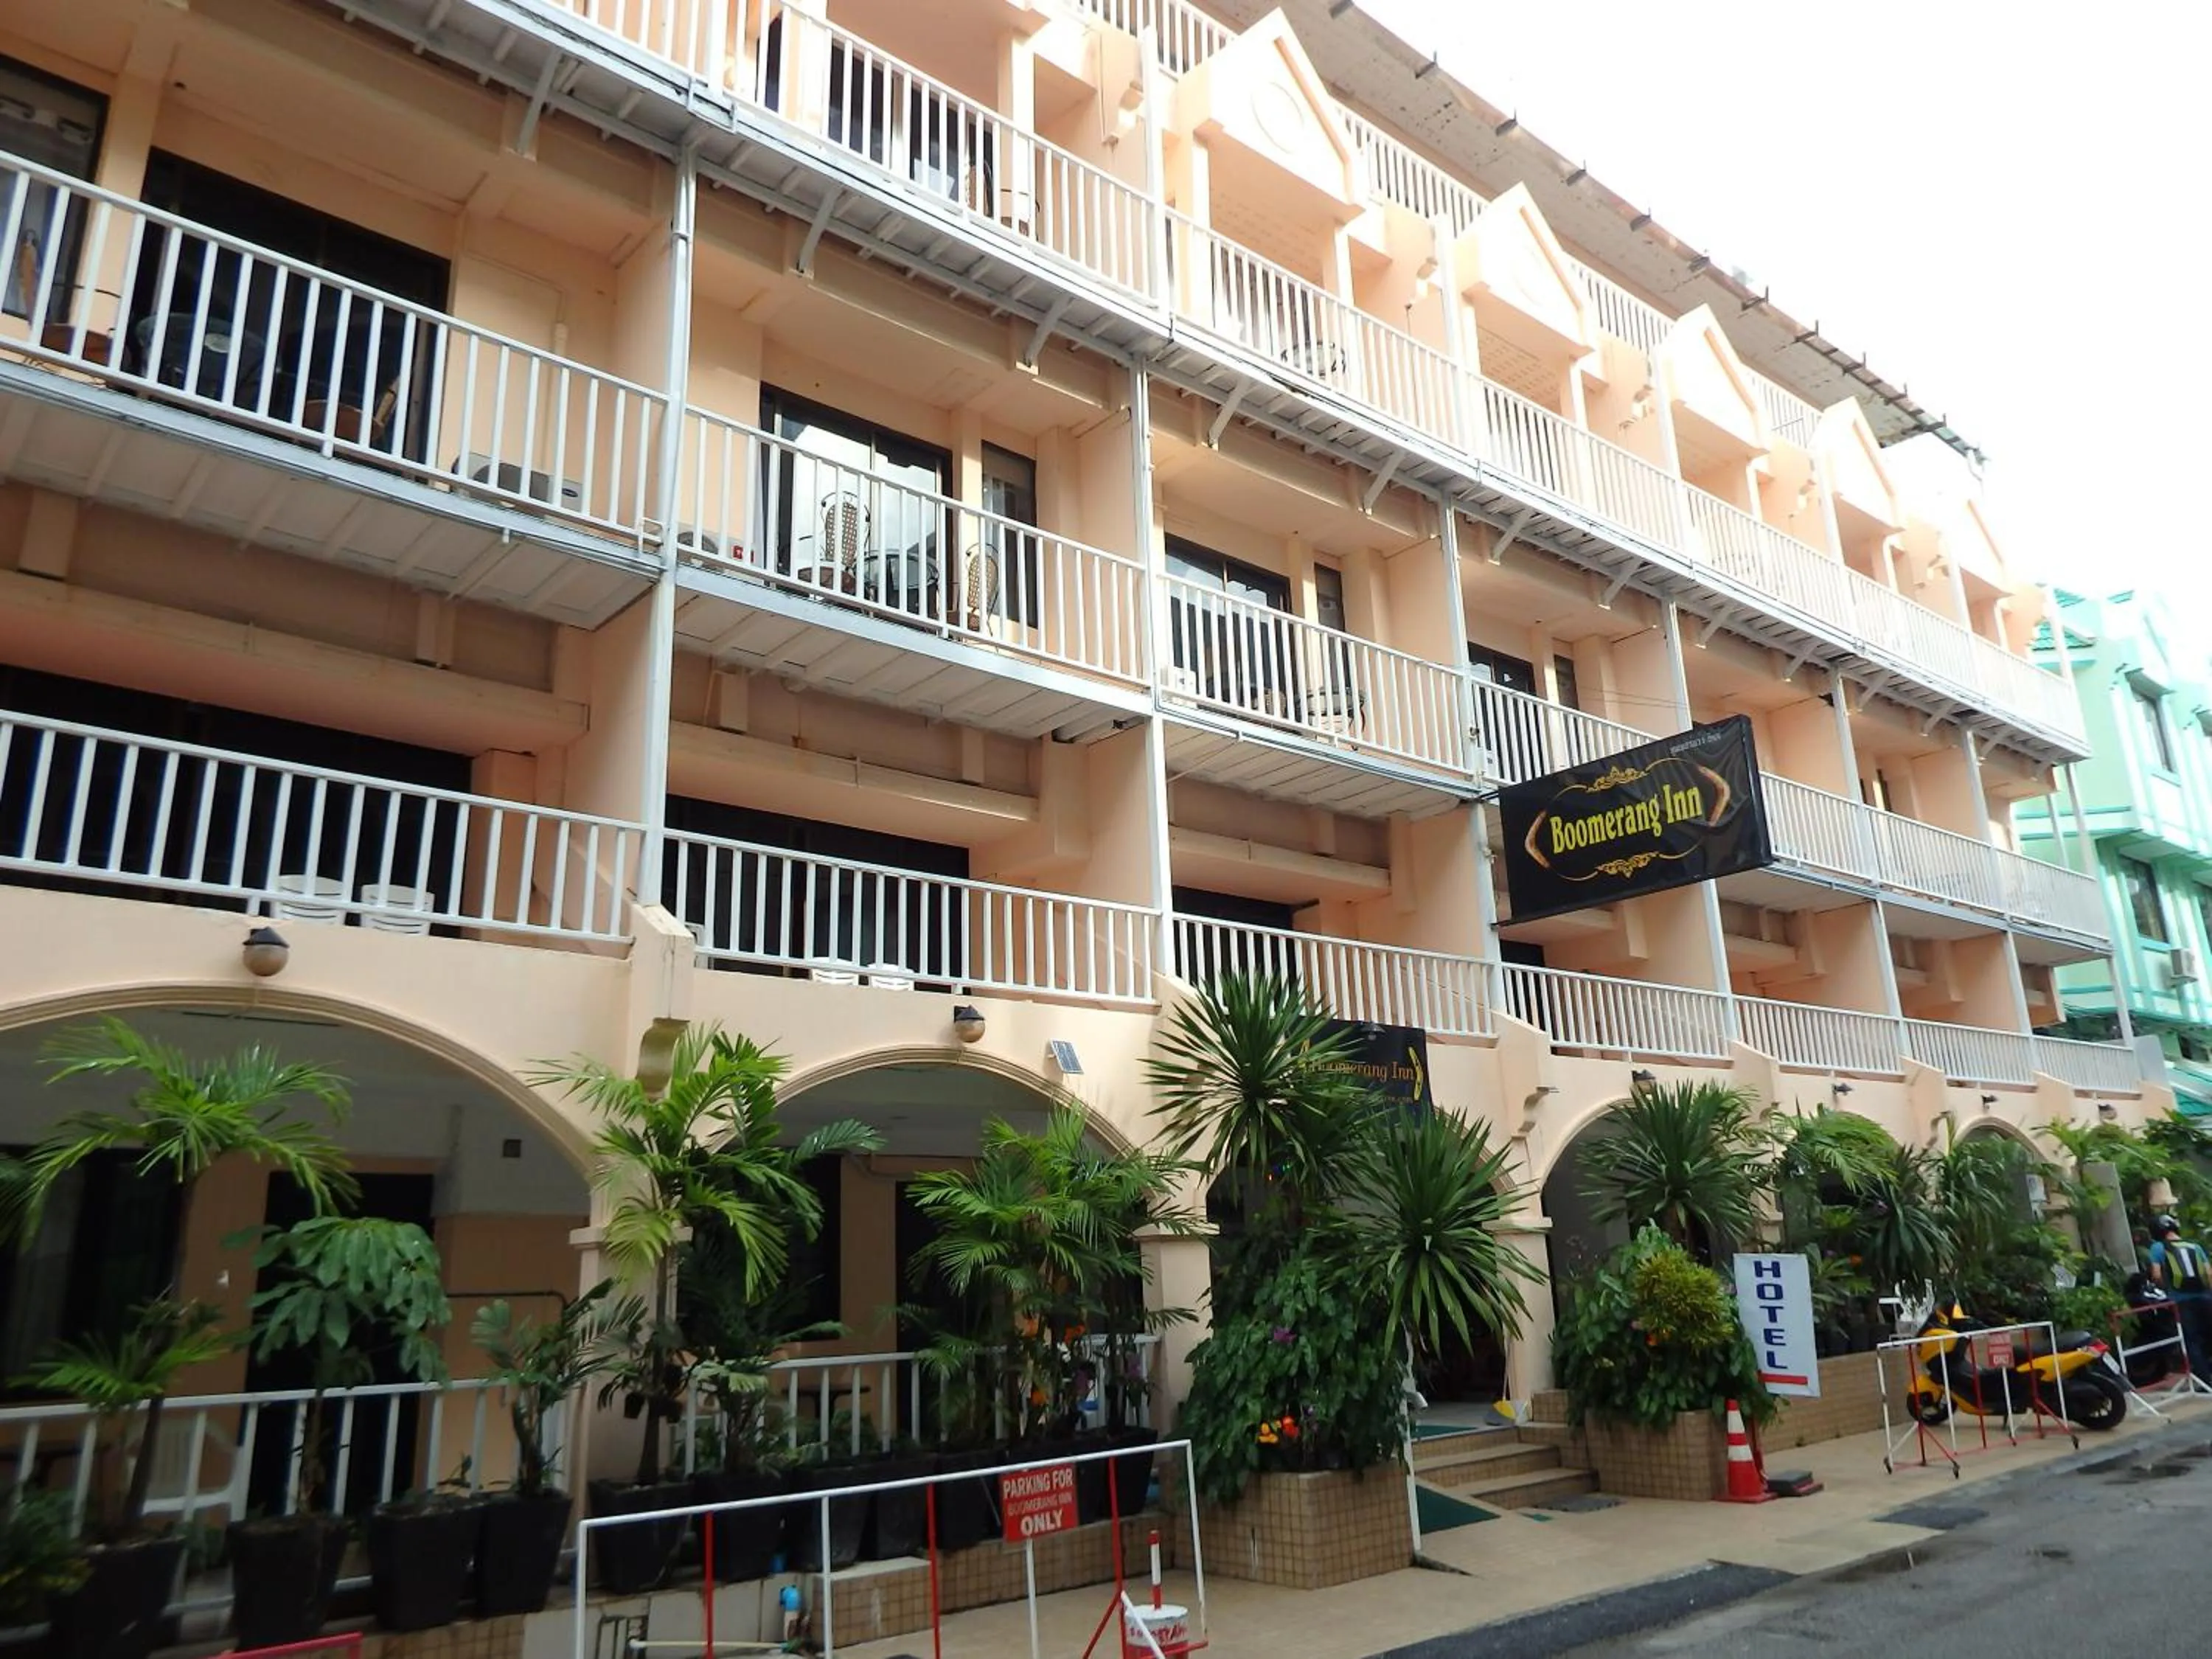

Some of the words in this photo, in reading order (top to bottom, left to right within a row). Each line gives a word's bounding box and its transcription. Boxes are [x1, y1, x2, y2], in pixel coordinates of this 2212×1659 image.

[1550, 797, 1660, 855] Boomerang
[1662, 784, 1703, 824] Inn
[1391, 1061, 1414, 1080] Inn
[1753, 1260, 1787, 1369] HOTEL
[1004, 1473, 1051, 1499] PARKING
[1052, 1468, 1073, 1489] FOR
[1020, 1507, 1062, 1536] ONLY
